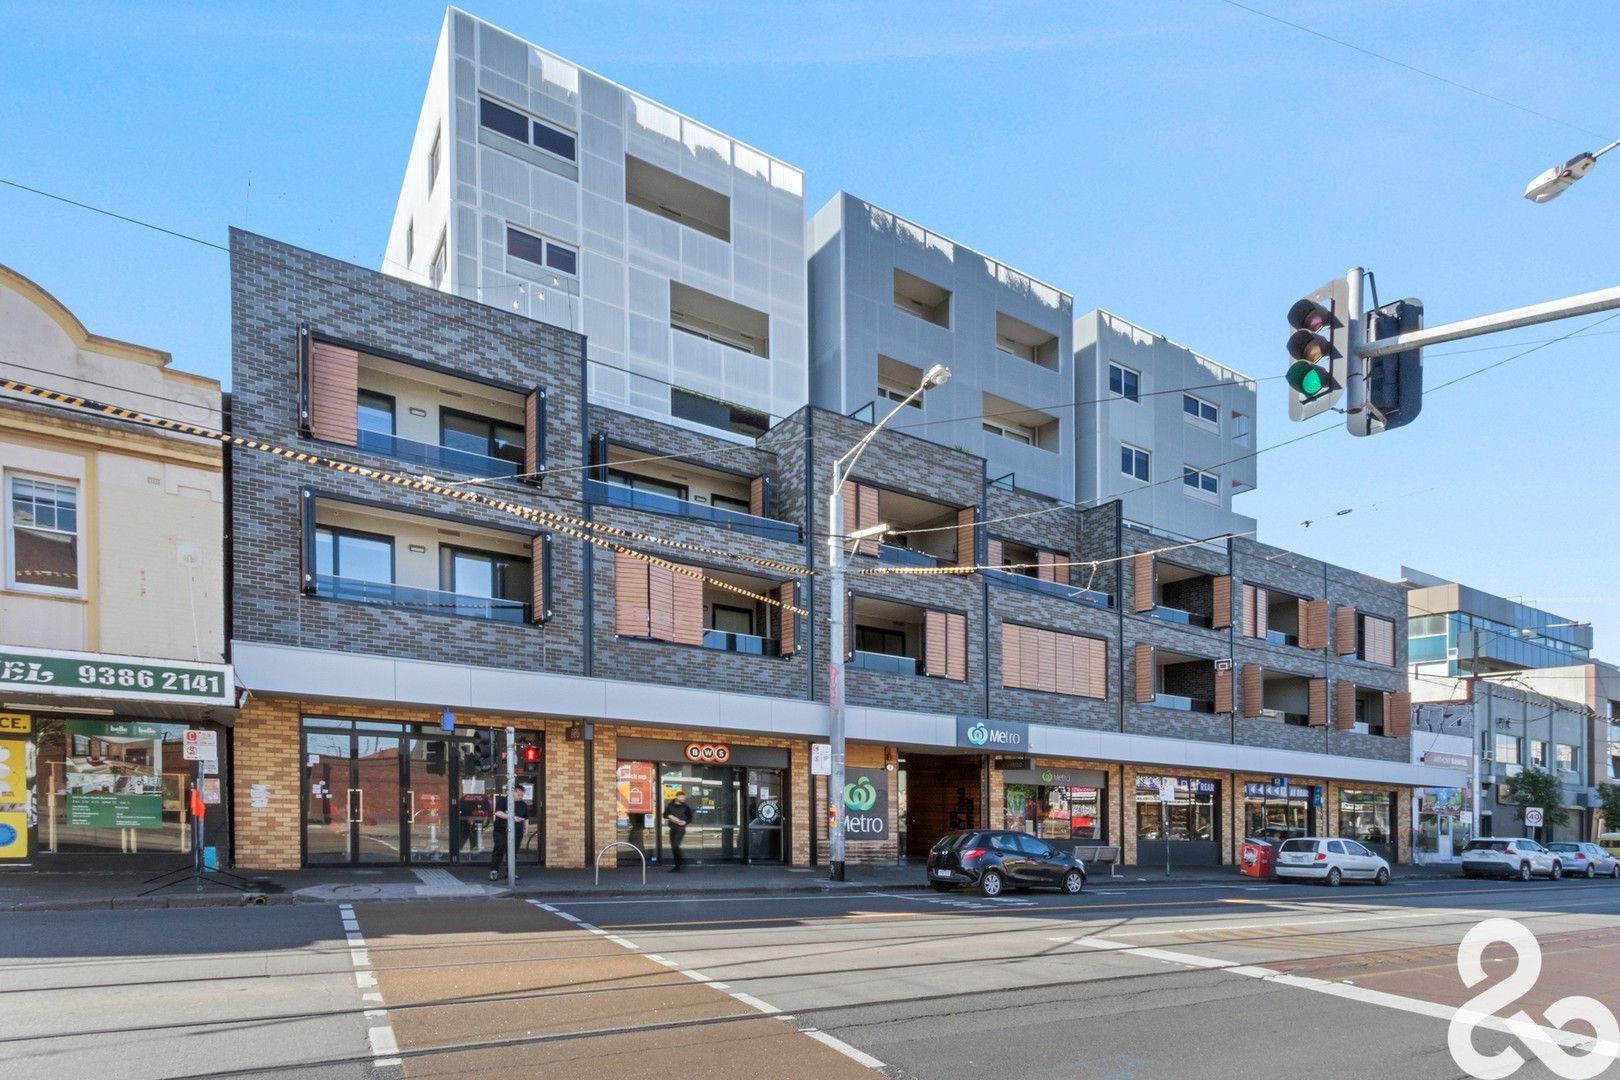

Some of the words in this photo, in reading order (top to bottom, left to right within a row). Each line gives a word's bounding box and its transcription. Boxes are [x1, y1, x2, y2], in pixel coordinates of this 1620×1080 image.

[78, 665, 154, 689] 9386
[162, 672, 219, 693] 2141
[989, 729, 1021, 744] Metro
[692, 748, 725, 758] BWS
